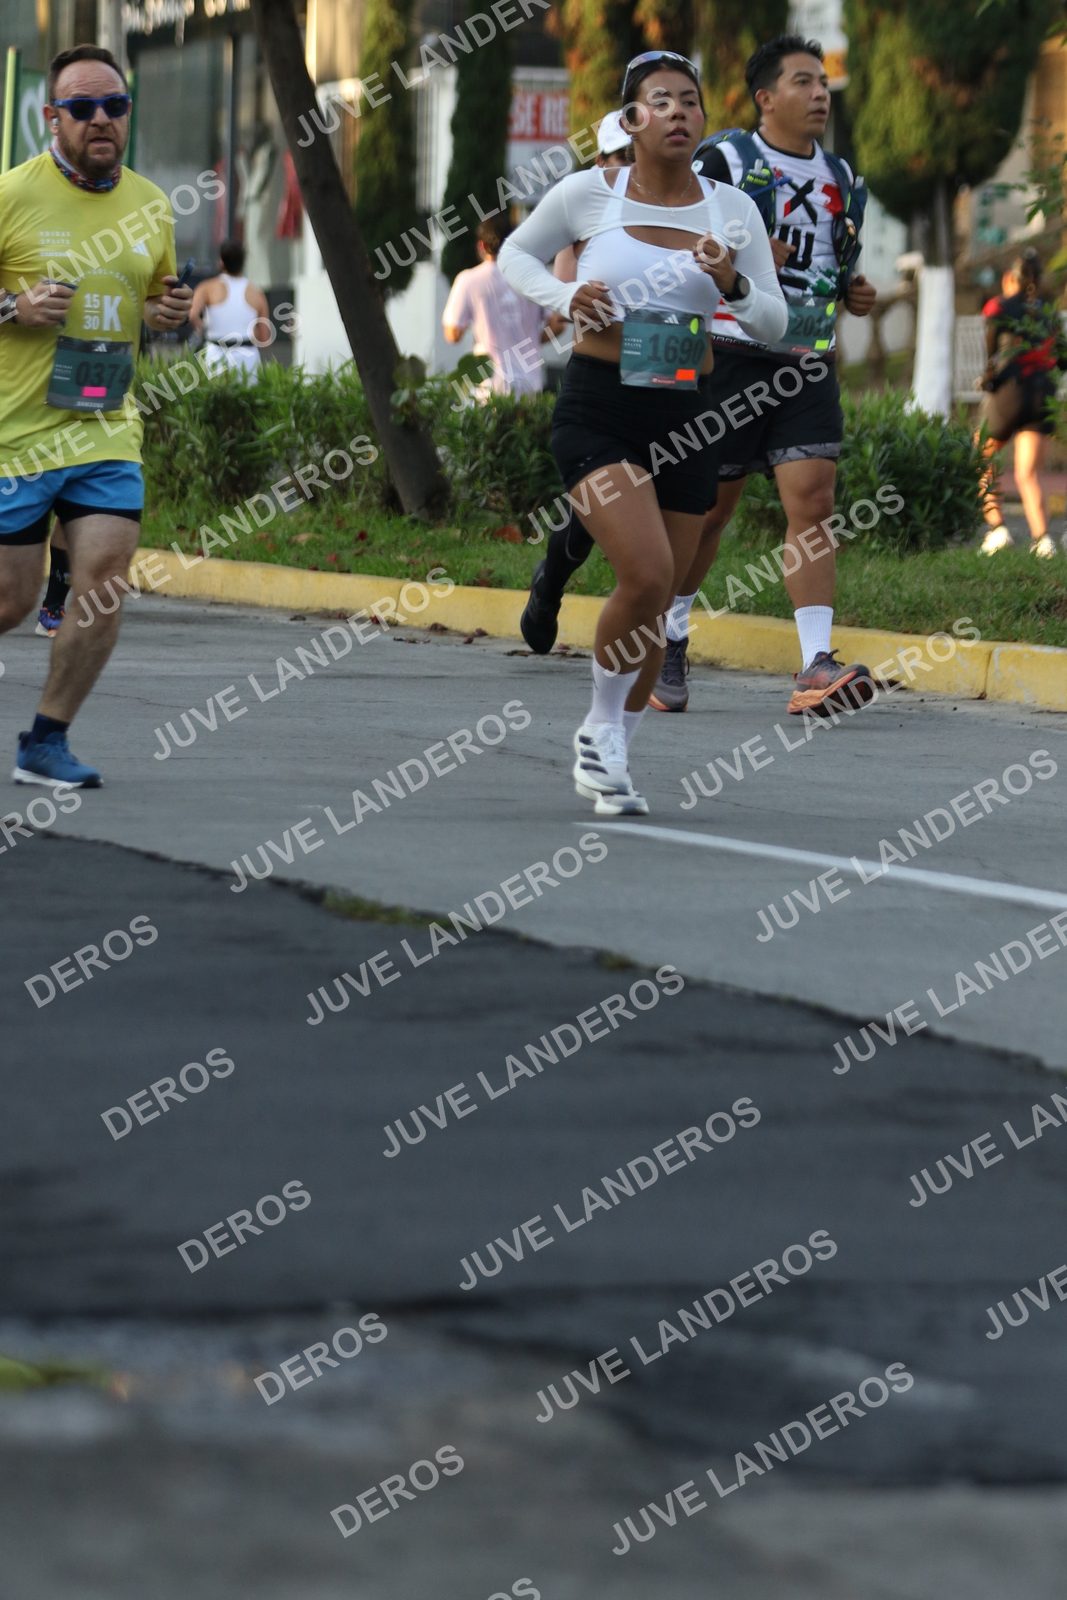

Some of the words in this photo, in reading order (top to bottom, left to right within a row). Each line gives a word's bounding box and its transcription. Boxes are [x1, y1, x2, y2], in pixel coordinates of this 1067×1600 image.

[84, 293, 100, 308] 15
[83, 315, 99, 330] 30
[103, 295, 122, 331] K
[648, 333, 706, 365] 1690
